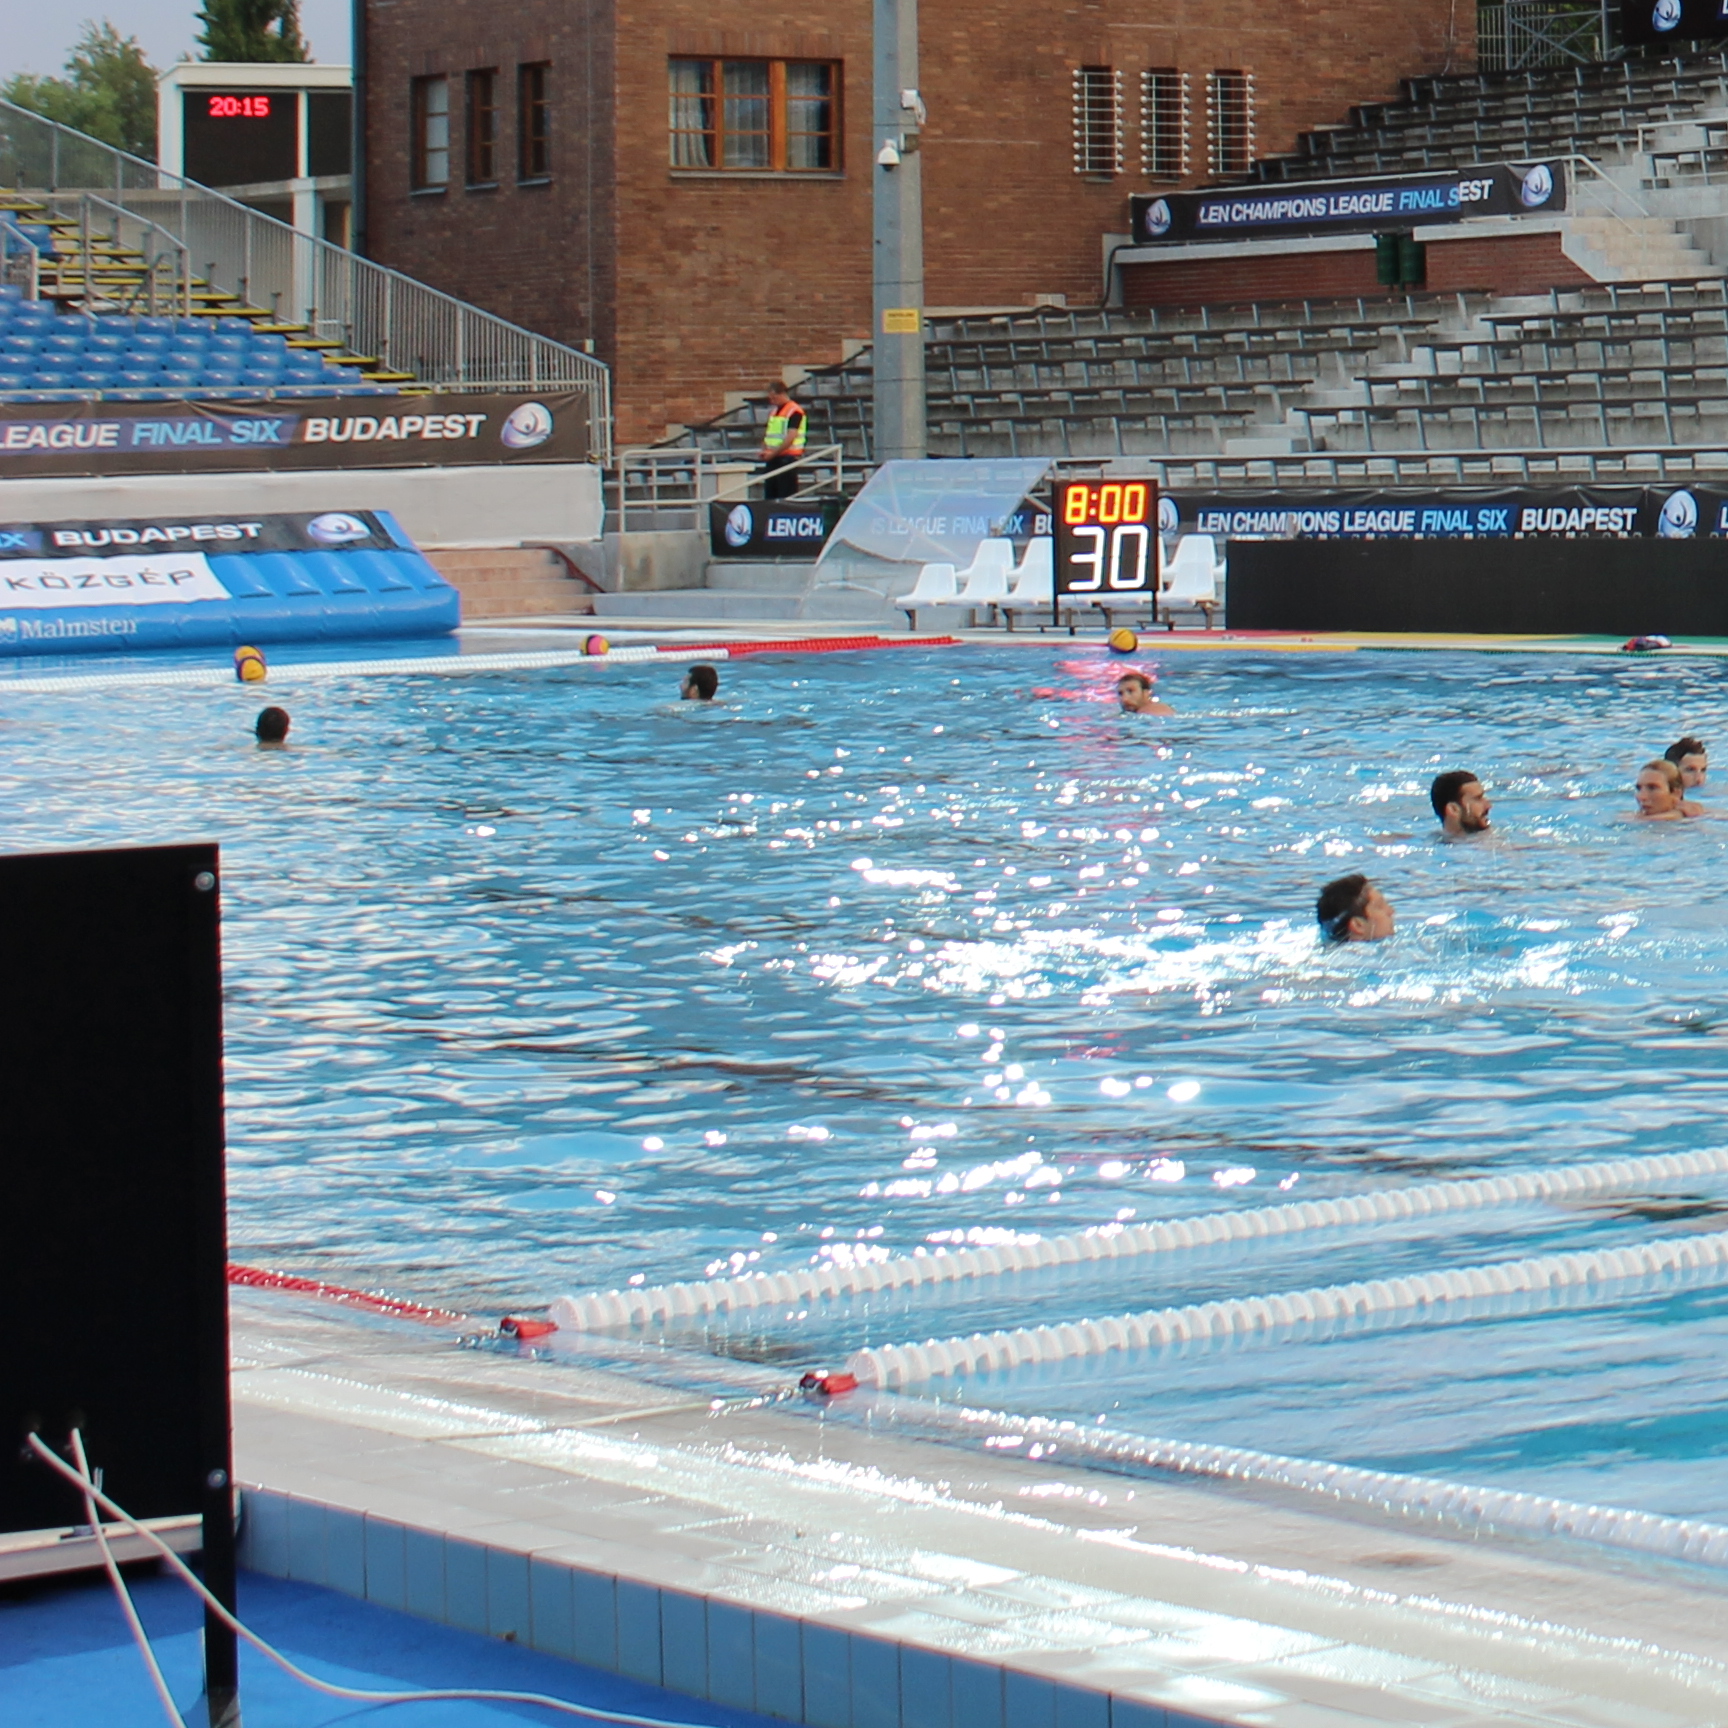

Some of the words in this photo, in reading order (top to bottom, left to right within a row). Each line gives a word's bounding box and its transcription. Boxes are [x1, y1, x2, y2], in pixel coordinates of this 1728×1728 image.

[209, 96, 270, 117] 20:15
[1200, 204, 1230, 223] LEN
[1231, 198, 1327, 222] CHAMPIONS
[1329, 193, 1394, 216] LEAGUE
[1398, 189, 1444, 211] FINAL
[0, 423, 120, 449] EAGUE
[131, 420, 222, 447] FINAL
[228, 419, 283, 444] SIX
[304, 413, 487, 443] BUDAPEST
[1065, 484, 1146, 524] 8:00
[767, 518, 796, 537] LEN
[1197, 512, 1232, 532] LEN
[1343, 510, 1414, 532] LEAGUE
[1421, 509, 1473, 531] FINAL
[1476, 508, 1508, 531] SIX
[1521, 507, 1638, 531] BUDAPEST
[53, 523, 263, 547] BUDAPEST
[1068, 524, 1150, 591] 30
[6, 567, 195, 590] KÖZGÉP
[20, 617, 138, 639] Malmsten
